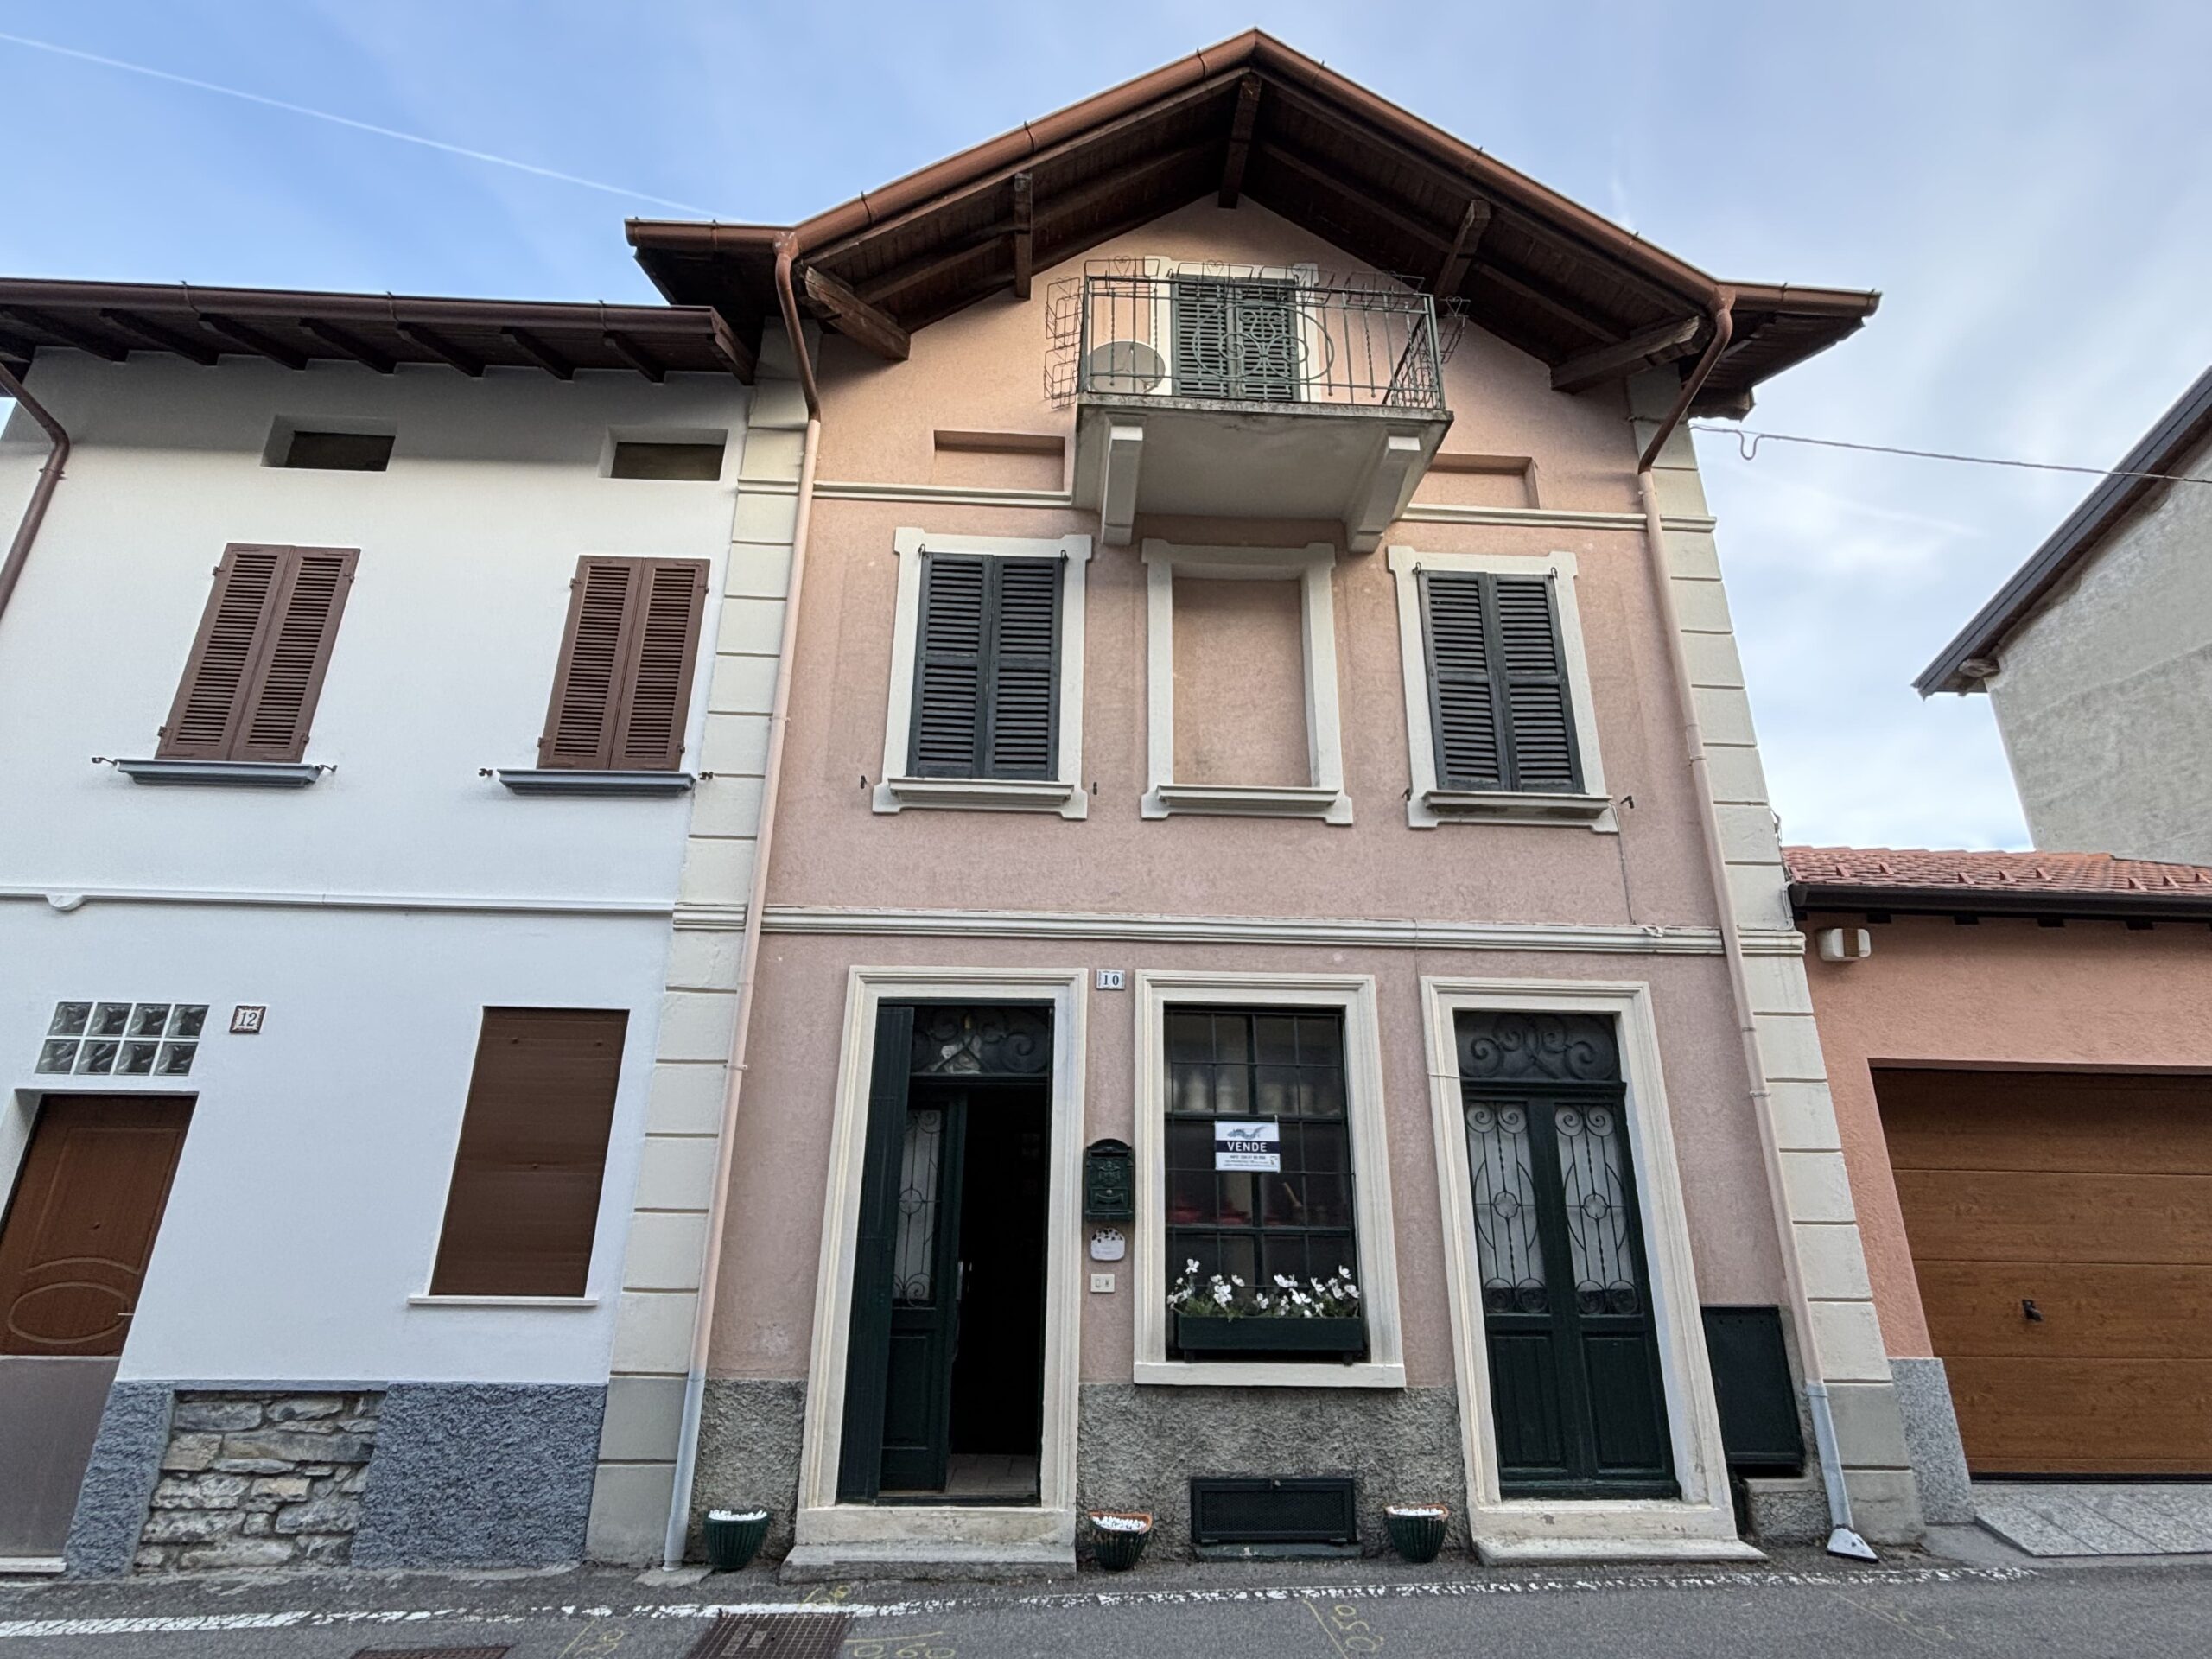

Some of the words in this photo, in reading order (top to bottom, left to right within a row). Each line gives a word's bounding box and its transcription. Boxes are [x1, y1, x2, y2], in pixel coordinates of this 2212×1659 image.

[1103, 974, 1120, 986] 10
[238, 1011, 258, 1027] 12
[1227, 1141, 1268, 1153] VENDE
